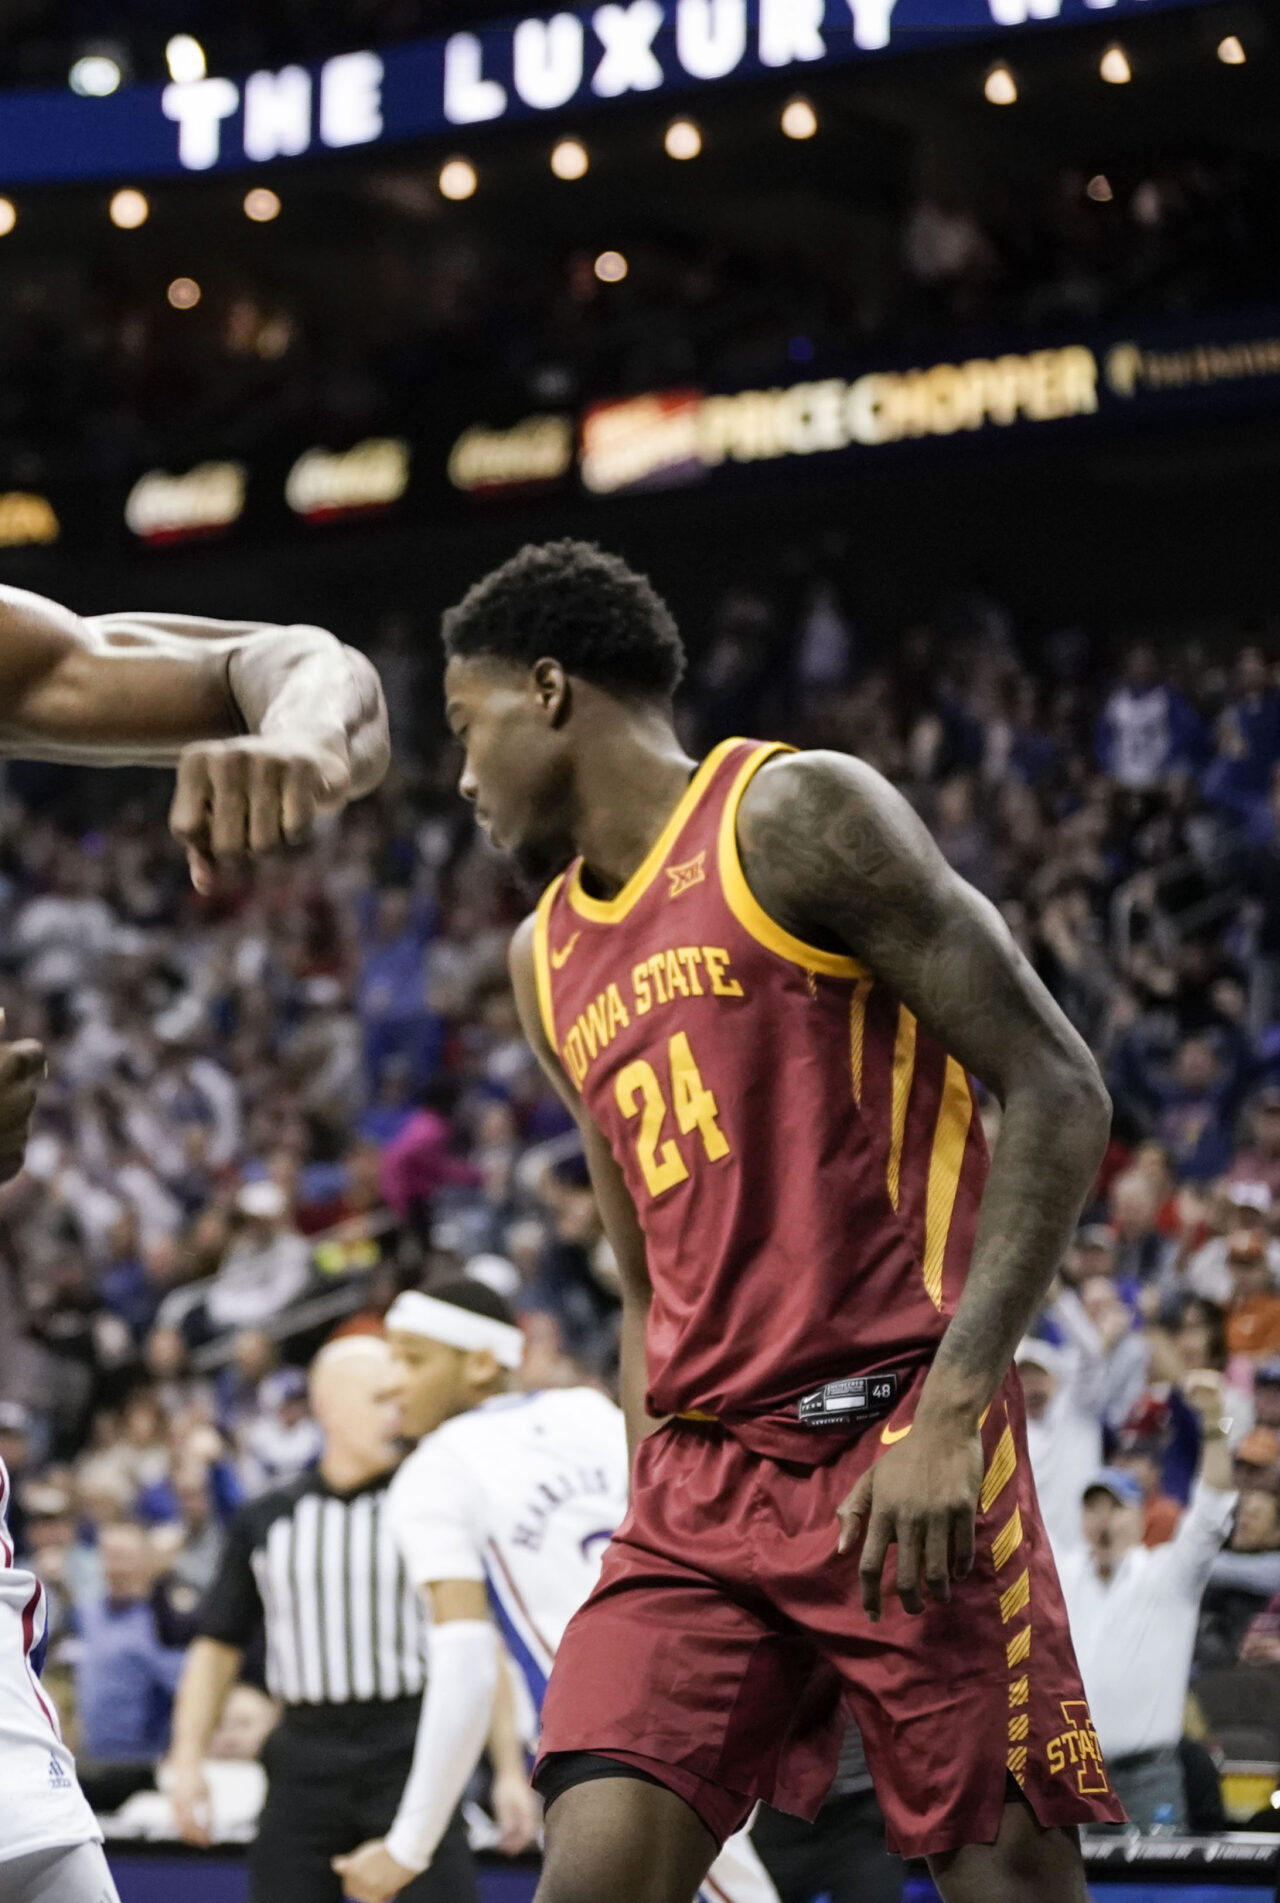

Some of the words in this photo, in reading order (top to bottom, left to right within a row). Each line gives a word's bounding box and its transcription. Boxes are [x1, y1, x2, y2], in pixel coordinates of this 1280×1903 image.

[161, 50, 385, 170] THE
[561, 983, 631, 1092] IOWA
[631, 946, 745, 1017] STATE
[614, 1030, 731, 1198] 24
[872, 1383, 891, 1398] 48
